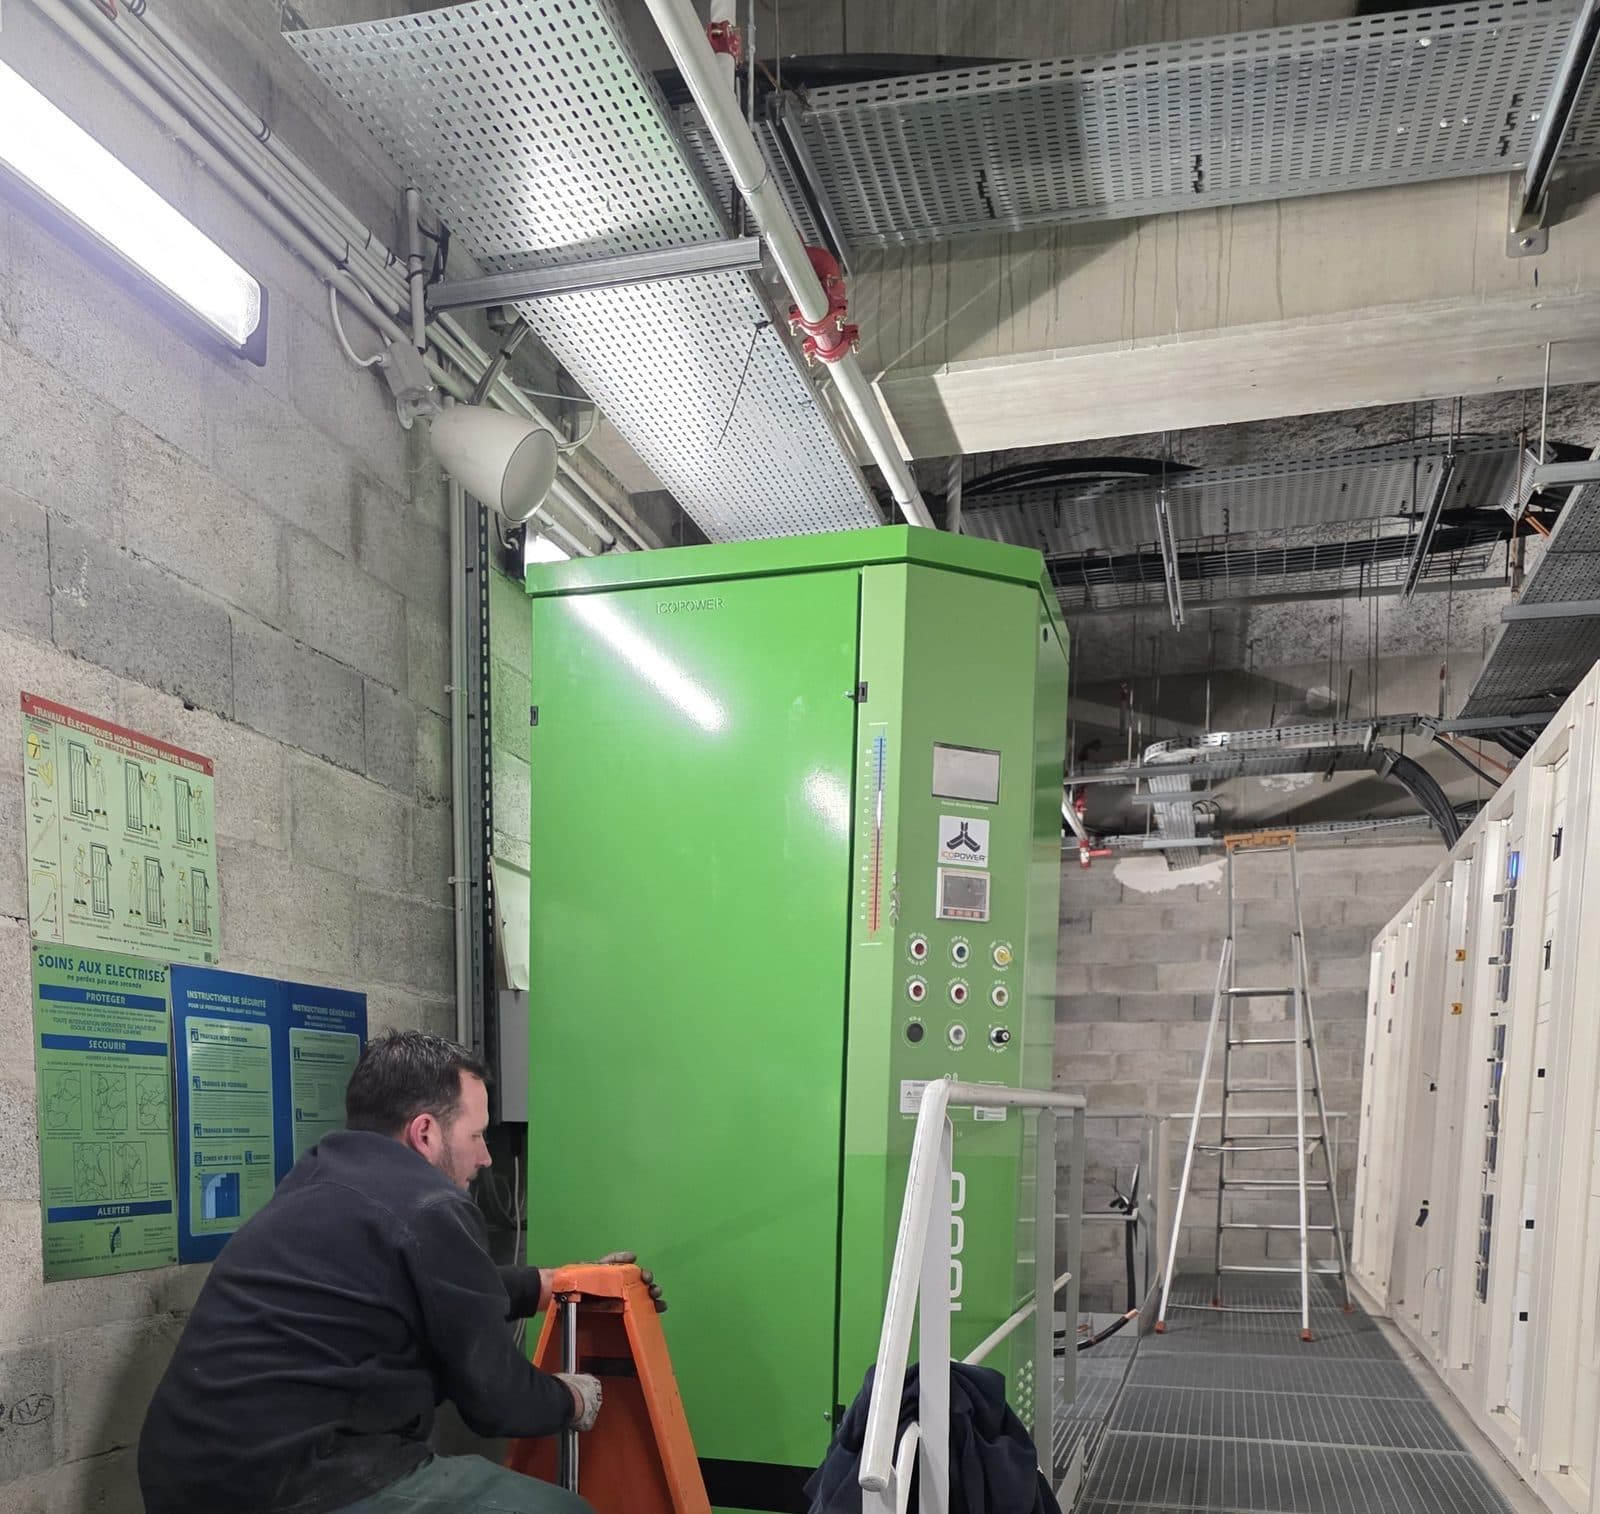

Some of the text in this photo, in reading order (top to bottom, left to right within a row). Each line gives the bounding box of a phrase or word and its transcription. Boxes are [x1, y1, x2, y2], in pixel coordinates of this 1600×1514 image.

[32, 705, 66, 726] TRAVAUX
[67, 715, 113, 742] ÉLECTRIQUES
[113, 732, 132, 747] HORS
[133, 738, 159, 757] TENSION
[159, 748, 180, 765] HAUTE
[180, 755, 205, 774] TENSION
[38, 954, 166, 983] SOINS AUX ELECTRISES
[97, 978, 107, 986] pas
[120, 979, 142, 989] seconde
[86, 991, 126, 1005] PROTEGER
[186, 990, 231, 1006] INSTRUCTIONS
[232, 996, 240, 1005] DE
[292, 1003, 329, 1016] INSTRUCTIONS
[88, 1040, 127, 1051] SECOURIR
[97, 1205, 131, 1217] ALERTER
